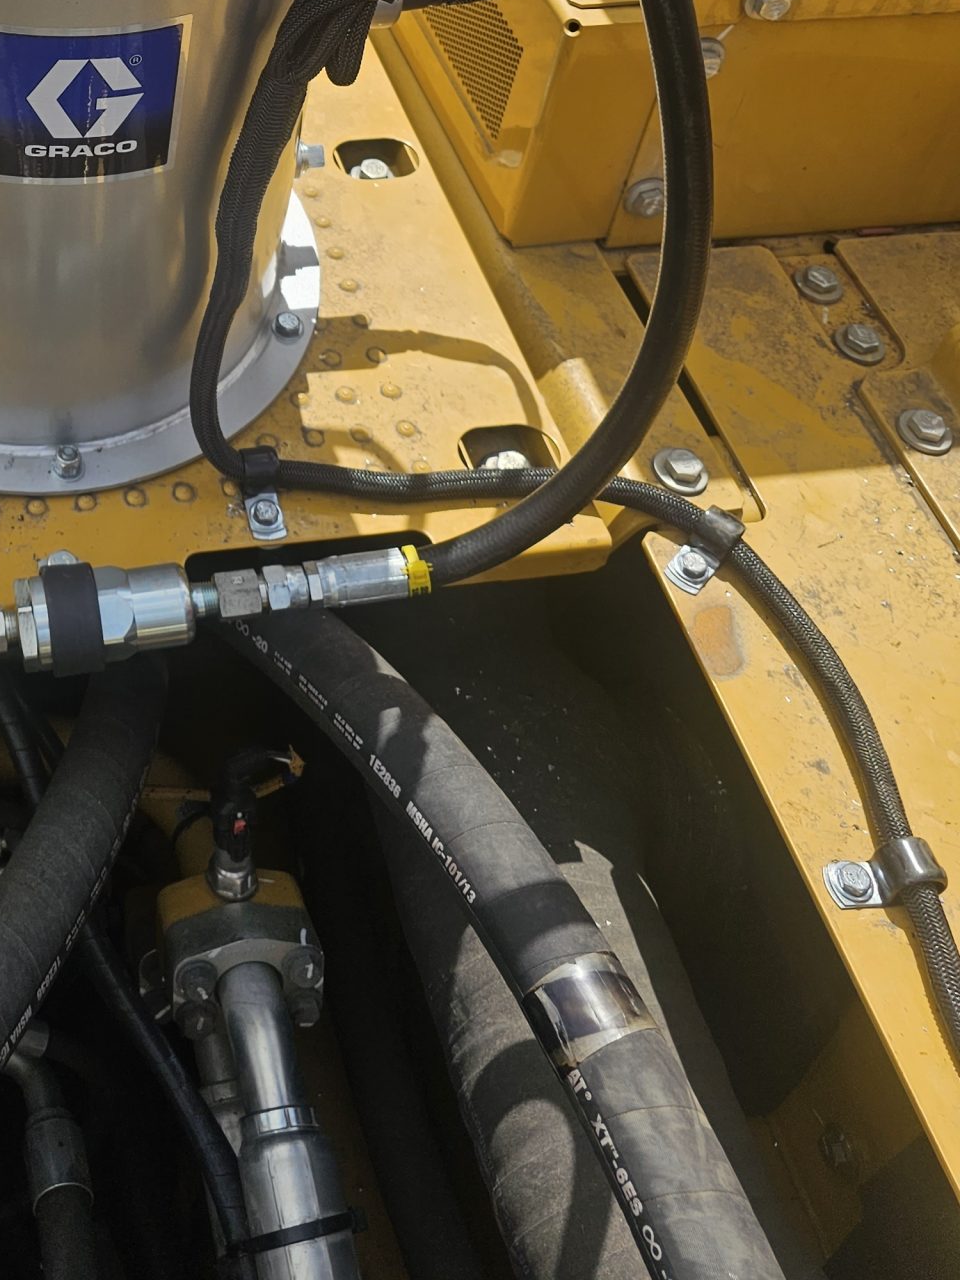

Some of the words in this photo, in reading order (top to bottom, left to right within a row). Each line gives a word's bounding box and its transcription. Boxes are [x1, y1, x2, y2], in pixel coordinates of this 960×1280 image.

[24, 139, 139, 158] GRACO
[368, 753, 402, 800] 1E2836
[404, 800, 434, 843] MSHA
[431, 836, 477, 905] IC-101/13
[9, 1003, 33, 1044] MSHA
